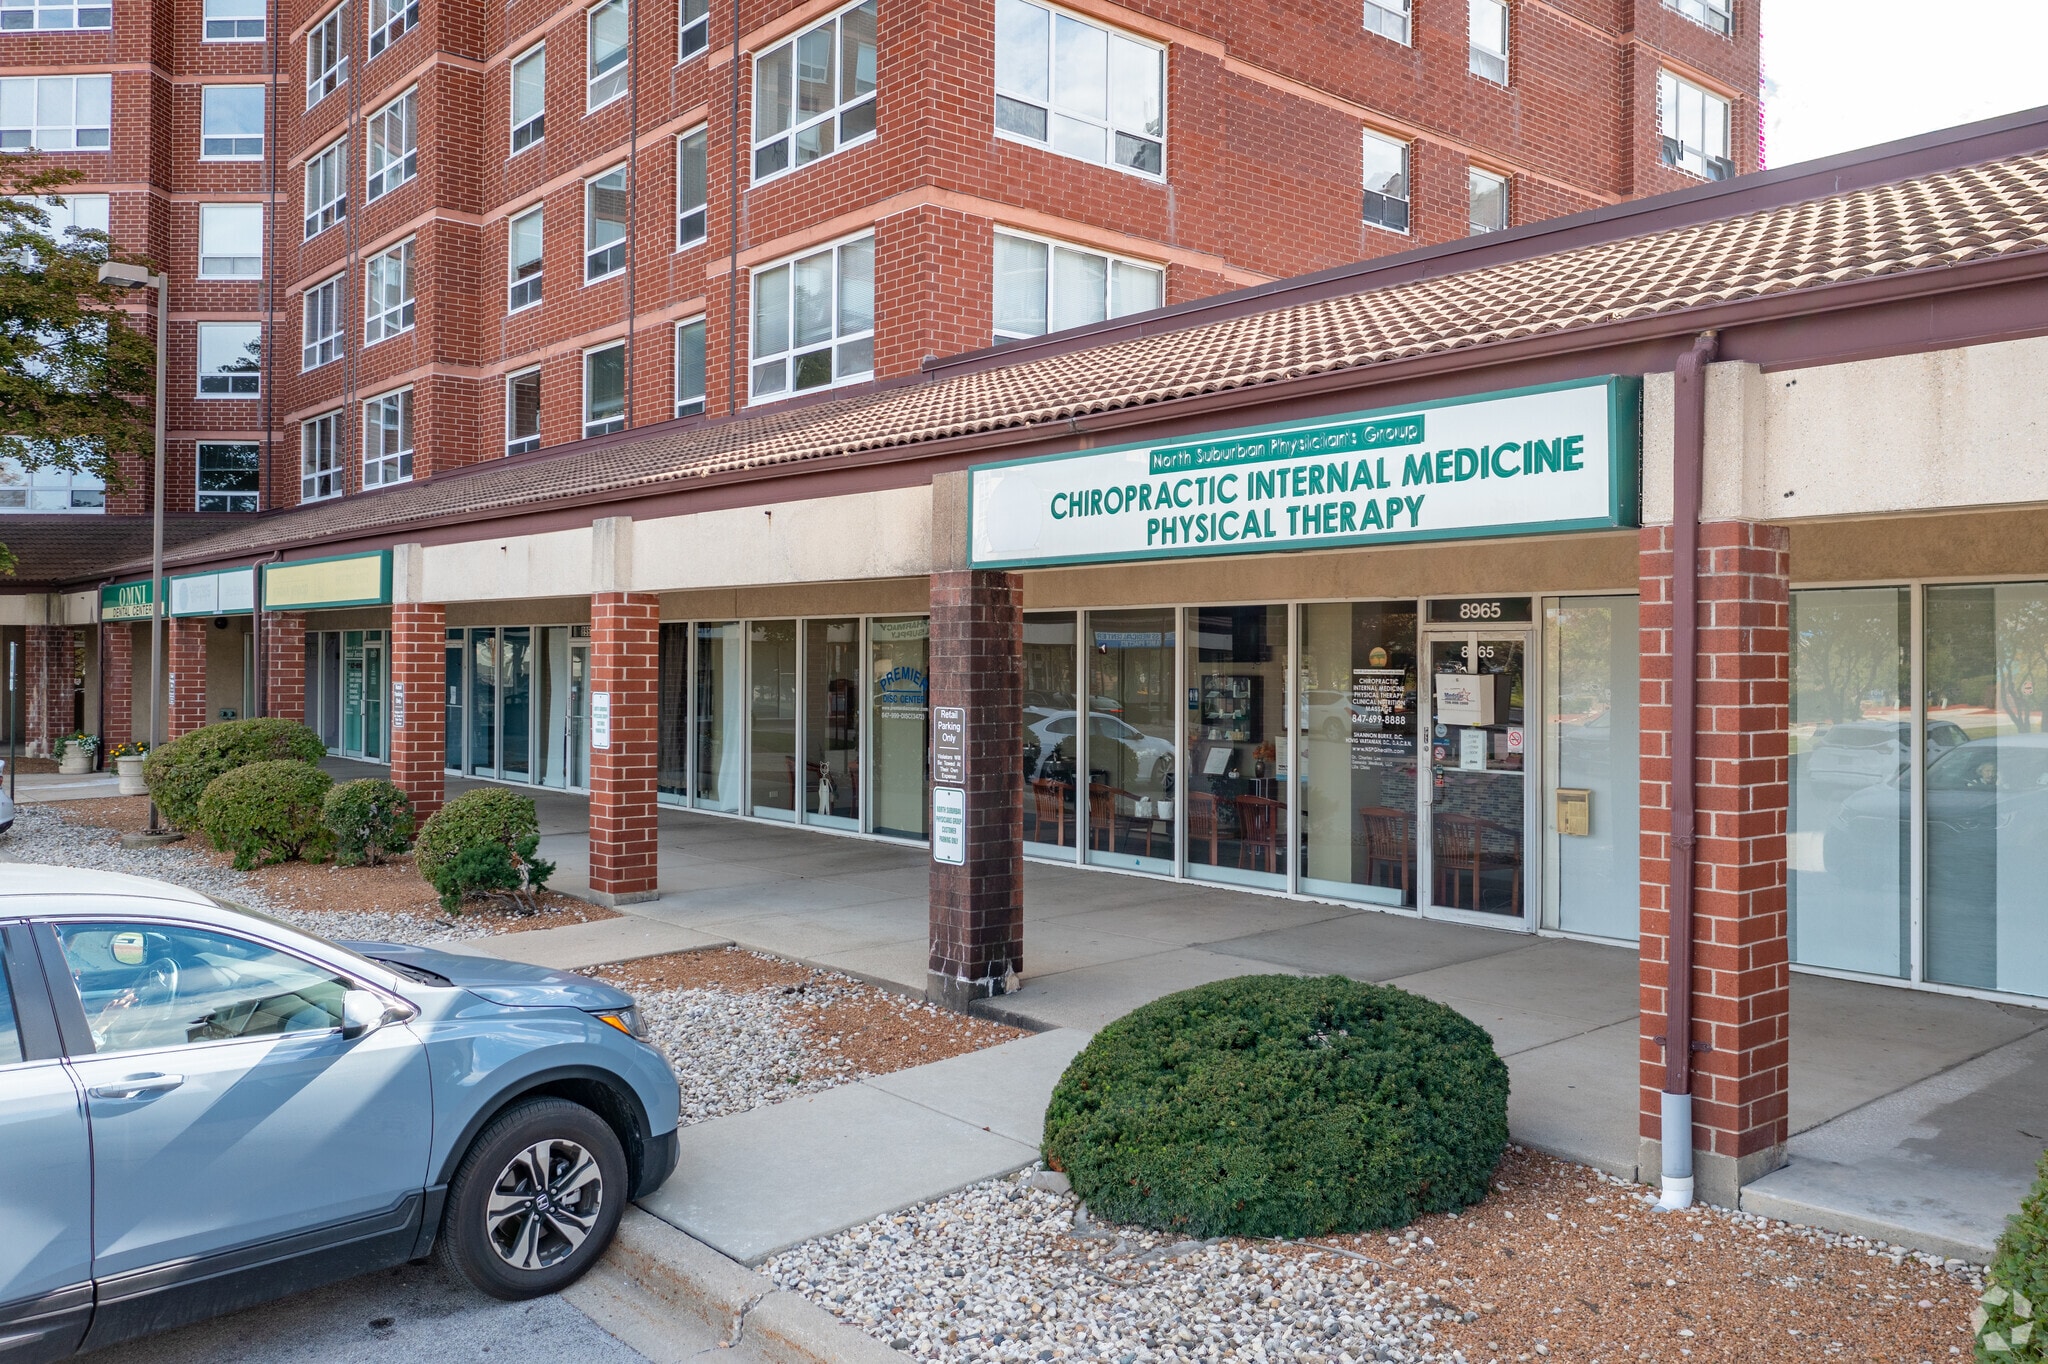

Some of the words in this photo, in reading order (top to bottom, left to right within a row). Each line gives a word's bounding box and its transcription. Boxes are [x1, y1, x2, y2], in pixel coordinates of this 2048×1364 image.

[1152, 451, 1192, 469] North
[1196, 442, 1265, 463] Suburban
[1362, 425, 1418, 444] Group
[1051, 473, 1238, 520] CHIROPRACTIC
[1248, 457, 1391, 501] INTERNAL
[1402, 435, 1584, 486] MEDICINE
[1147, 508, 1276, 546] PHYSICAL
[1286, 494, 1426, 536] THERAPY
[118, 585, 147, 606] OMNI
[113, 606, 130, 618] DENTAL
[132, 604, 152, 616] CENTER
[1460, 602, 1501, 619] 8965
[1461, 646, 1494, 658] 865
[883, 694, 897, 703] DISC
[901, 695, 926, 704] CENTER
[940, 710, 958, 719] Retail
[1352, 714, 1406, 725] 847-699-8888
[938, 721, 960, 732] Parking
[942, 733, 956, 743] Only
